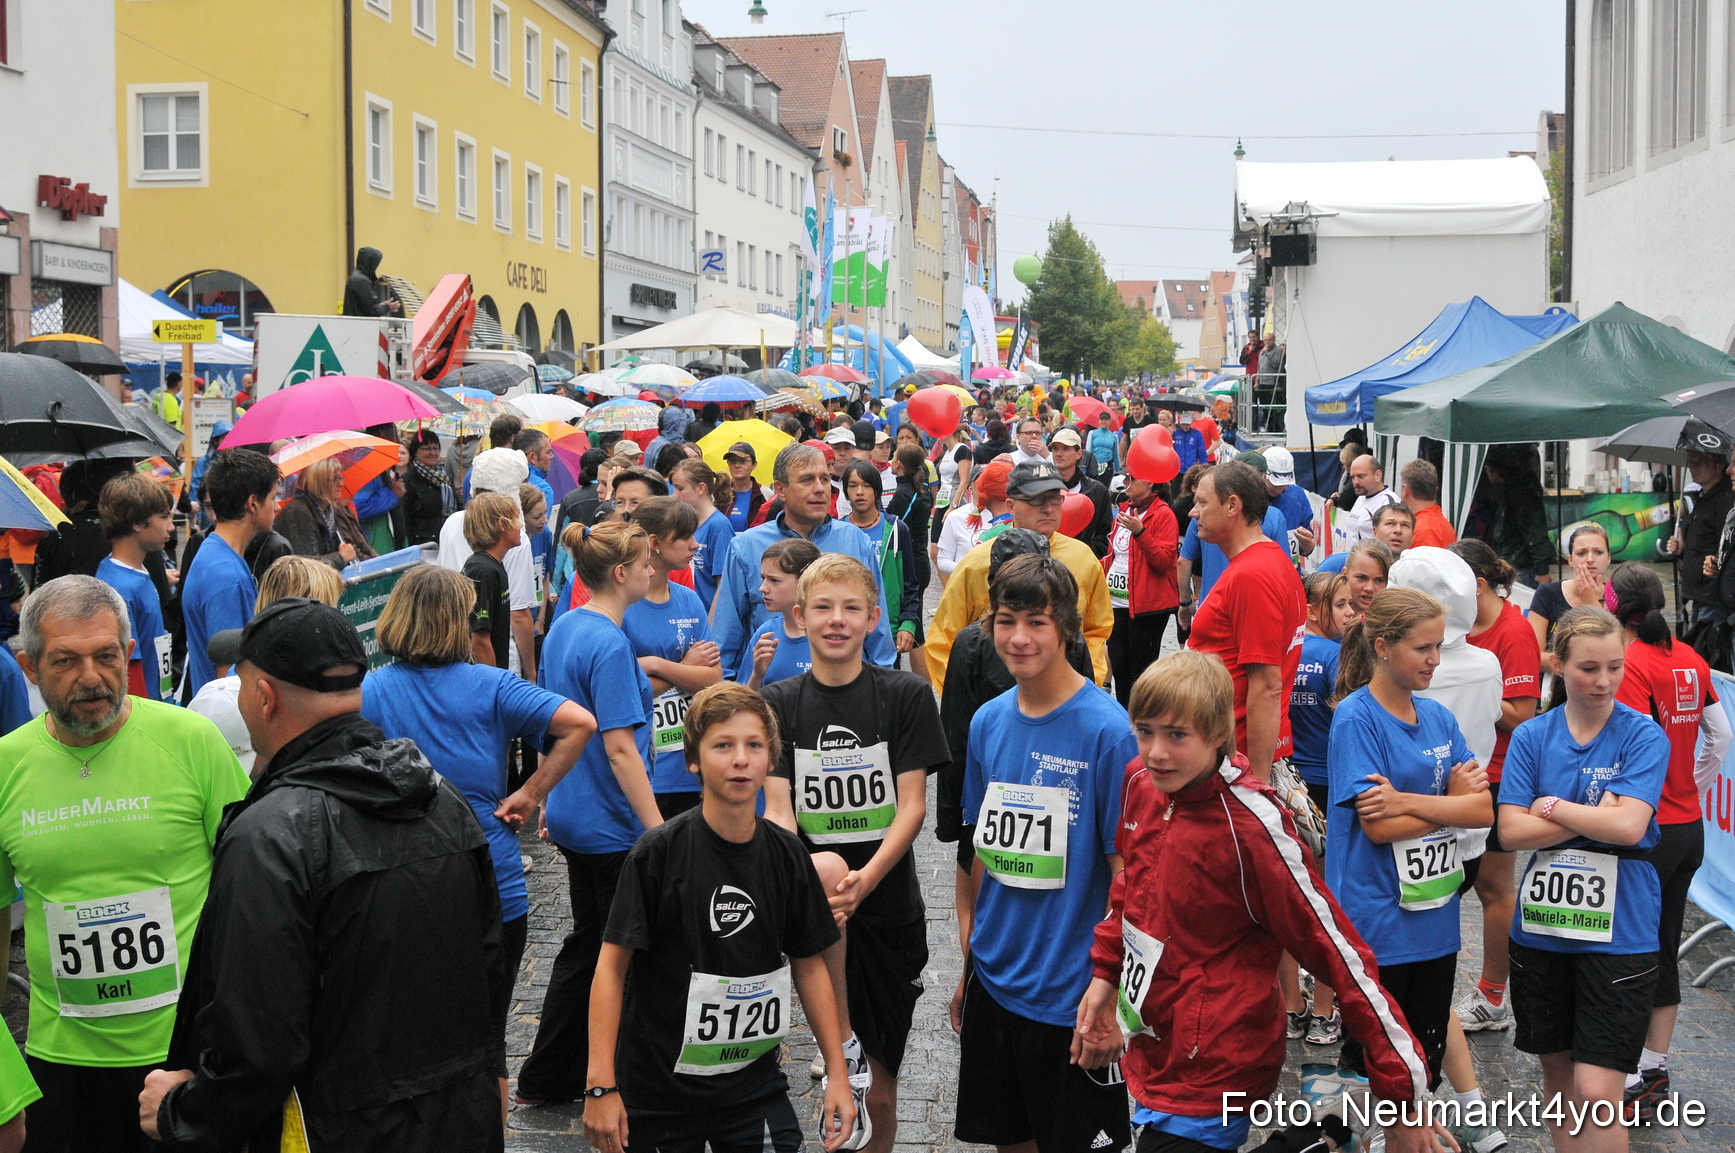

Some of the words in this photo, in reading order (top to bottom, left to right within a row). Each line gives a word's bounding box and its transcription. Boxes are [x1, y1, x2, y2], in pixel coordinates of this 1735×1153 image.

[44, 254, 59, 267] BABY
[61, 256, 66, 268] &
[67, 258, 109, 273] KINDERMODEN
[506, 260, 528, 290] CAFE
[530, 265, 548, 294] DELI
[165, 322, 204, 331] Duschen
[168, 332, 202, 340] Freibad
[1108, 573, 1129, 590] 503
[821, 738, 857, 748] saller
[821, 754, 863, 766] BOCK
[1031, 751, 1041, 760] 12.
[1041, 754, 1089, 770] NEUMARKTER
[1039, 761, 1079, 776] STADTLAUF
[804, 770, 886, 810] 5006
[1002, 790, 1034, 802] BOCK
[74, 816, 118, 828] WOHNEN.
[122, 813, 153, 822] LEBEN.
[827, 816, 868, 831] Johan
[983, 809, 1052, 852] 5071
[994, 855, 1034, 874] Florian
[1405, 838, 1458, 881] 5227
[1530, 871, 1606, 909] 5063
[77, 901, 130, 921] BOCK
[715, 902, 751, 911] saller
[1523, 907, 1610, 930] Gabriela-Marie
[58, 921, 165, 975] 5186
[96, 979, 132, 1000] Karl
[727, 980, 767, 995] BOCK
[697, 997, 781, 1042] 5120
[719, 1046, 749, 1061] Niko
[1090, 1138, 1114, 1149] adidas
